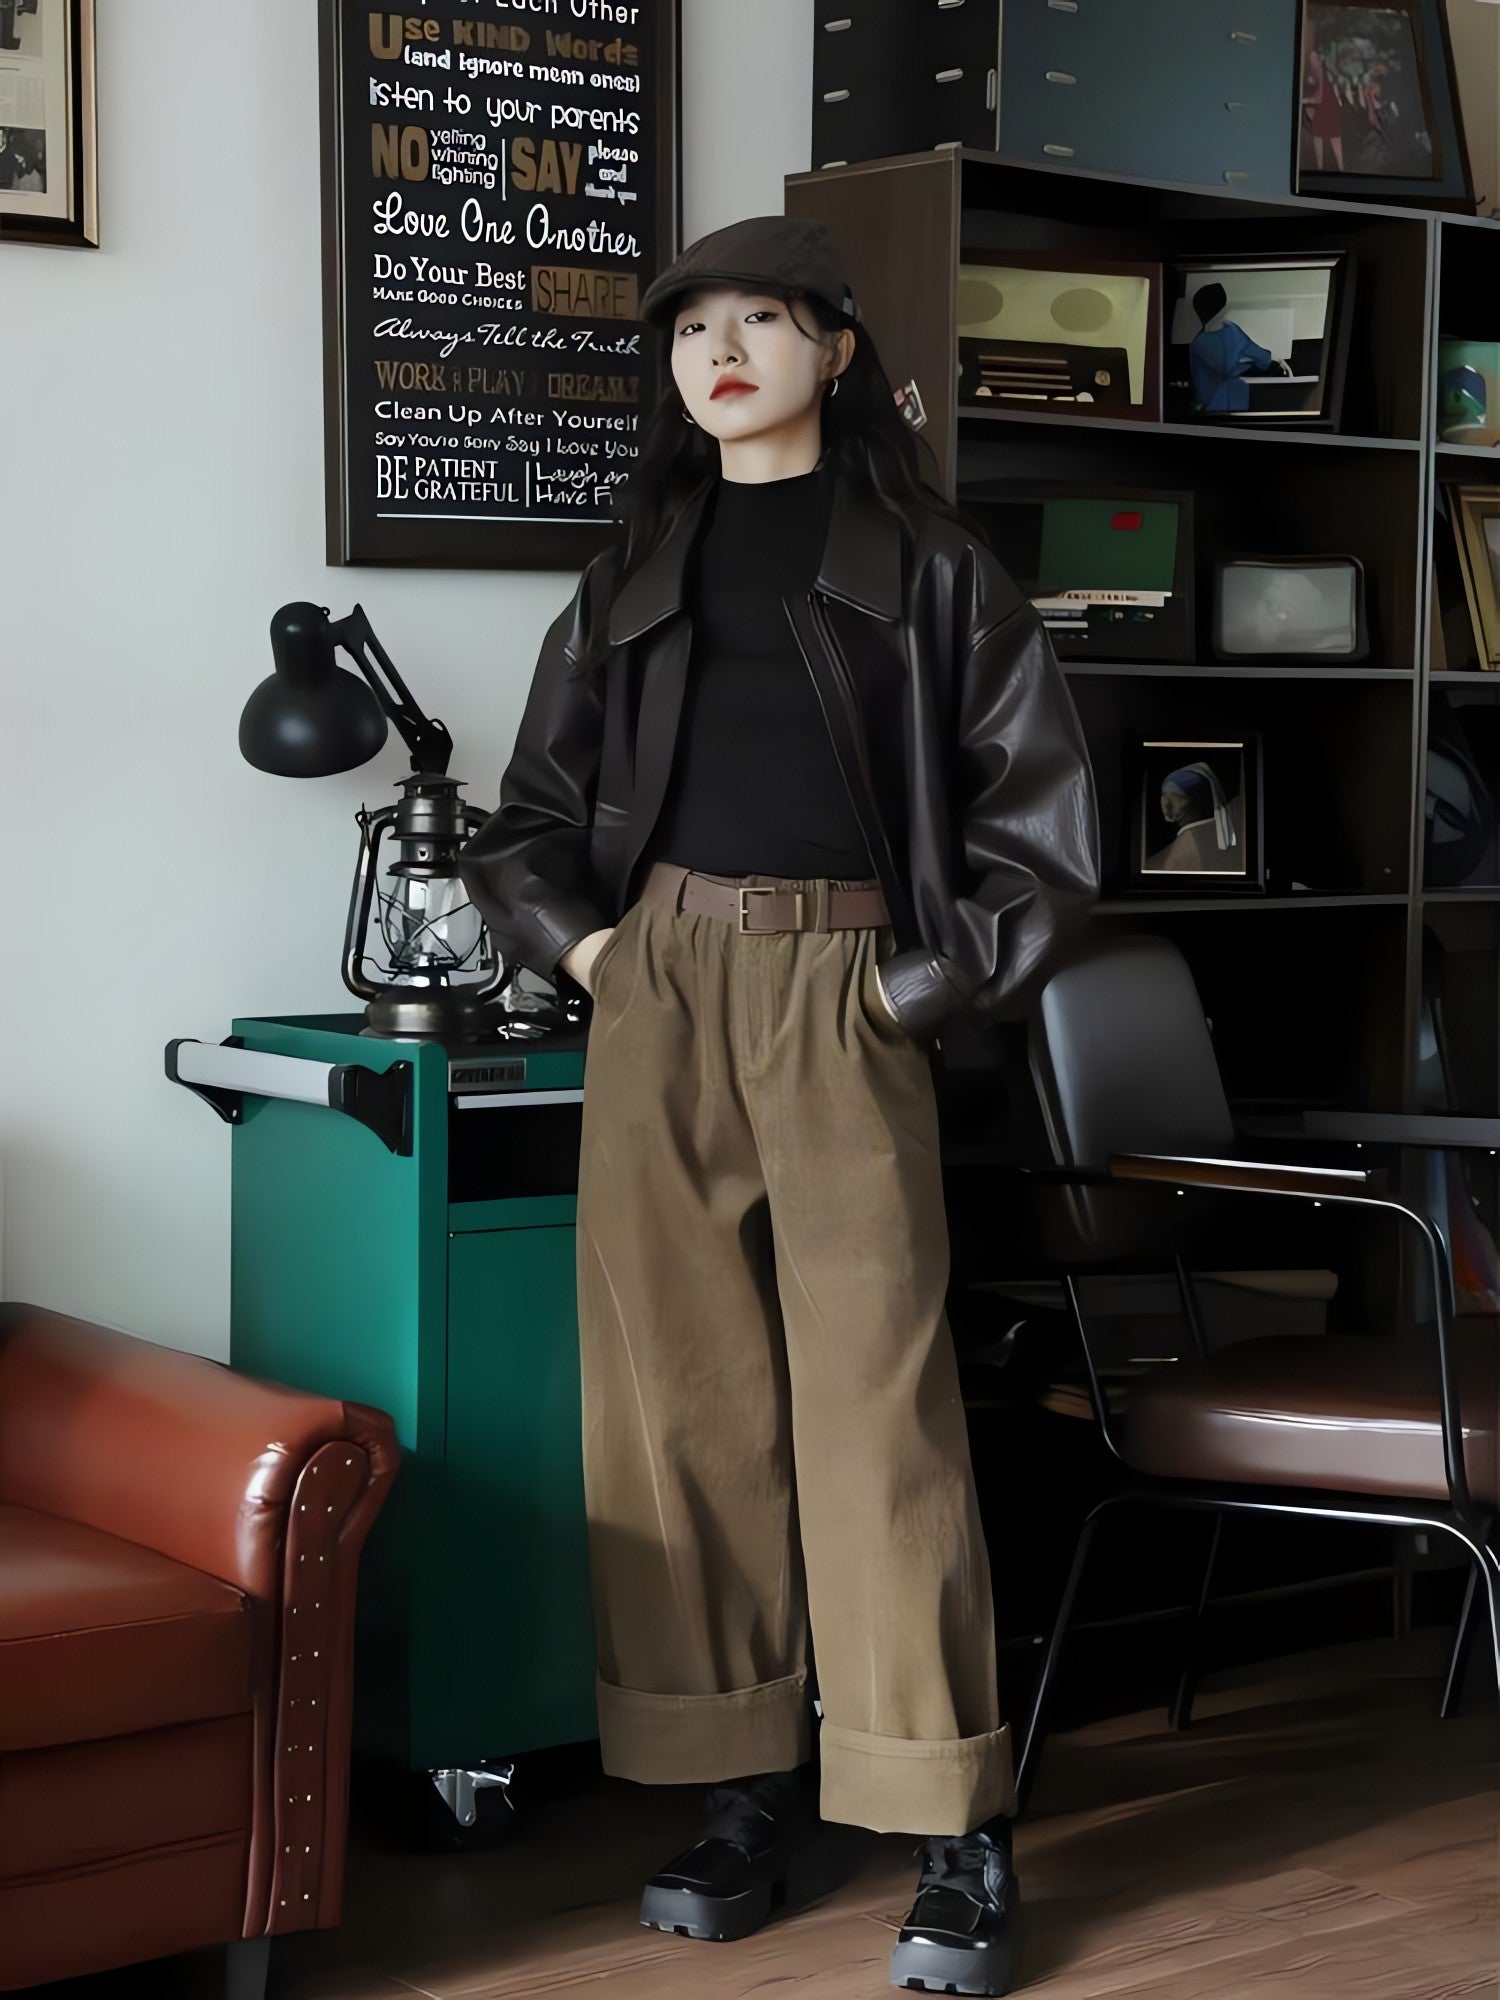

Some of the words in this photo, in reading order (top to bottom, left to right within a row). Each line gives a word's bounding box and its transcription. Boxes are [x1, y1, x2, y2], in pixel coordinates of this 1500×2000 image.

[570, 0, 639, 25] Other
[368, 12, 440, 60] Use
[452, 19, 531, 52] KIND
[442, 86, 472, 115] to
[486, 97, 542, 128] your
[371, 122, 430, 182] NO
[510, 136, 583, 195] SAY
[372, 191, 450, 238] Love
[460, 197, 516, 244] One
[526, 203, 642, 258] Another
[373, 253, 407, 280] Do
[409, 256, 469, 285] Your
[474, 262, 526, 291] Best
[537, 269, 629, 317] SHARE
[373, 317, 476, 359] Always
[477, 323, 528, 347] Tell
[531, 327, 568, 350] the
[374, 359, 447, 392] WORK
[374, 400, 442, 420] Clean
[448, 404, 482, 427] Up
[489, 407, 545, 426] After
[552, 409, 639, 432] Yourself
[375, 454, 409, 499] BE
[414, 456, 499, 479] PATIENT
[414, 478, 520, 503] GRATEFUL
